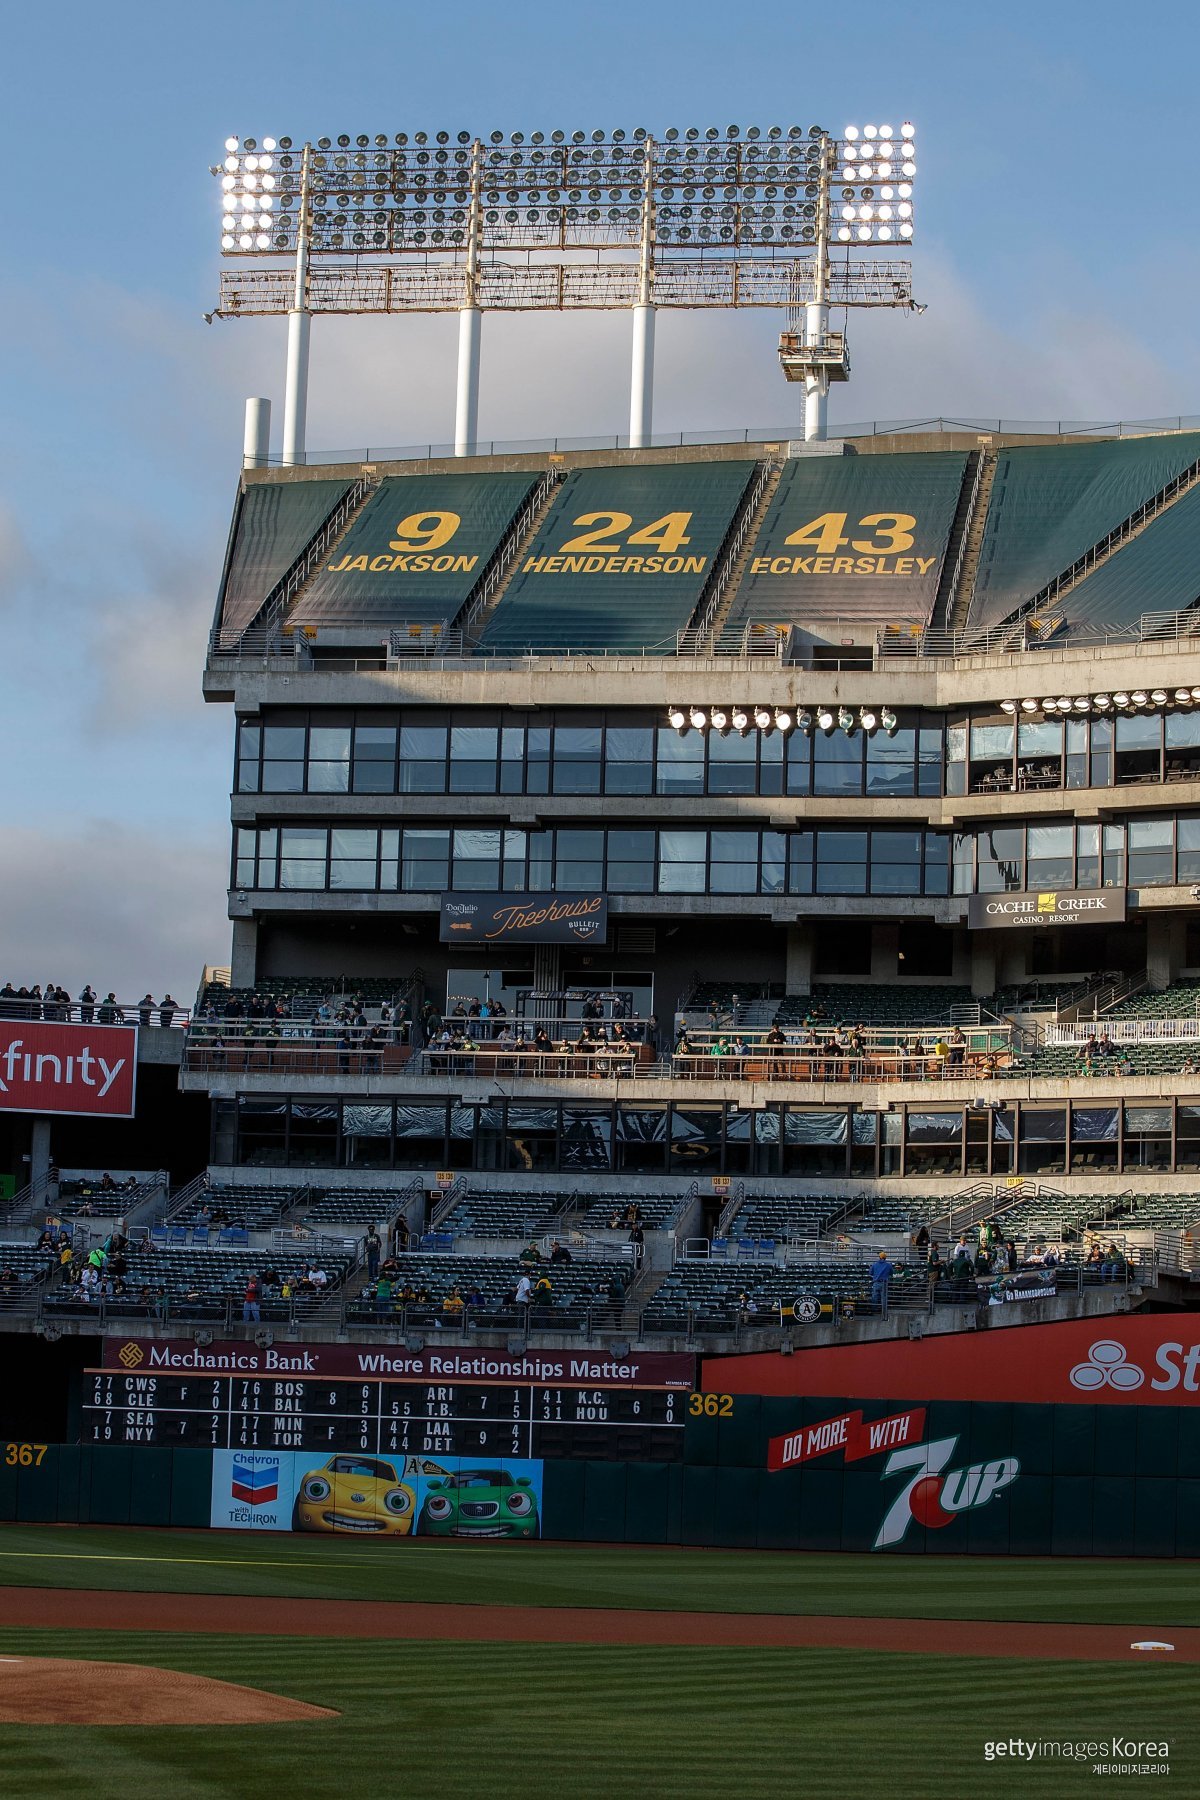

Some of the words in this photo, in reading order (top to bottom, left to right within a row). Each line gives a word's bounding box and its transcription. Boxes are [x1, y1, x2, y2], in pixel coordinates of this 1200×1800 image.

[389, 511, 461, 552] 9
[559, 511, 692, 554] 24
[784, 512, 917, 555] 43
[328, 555, 478, 573] JACKSON
[523, 555, 707, 575] HENDERSON
[750, 557, 936, 576] ECKERSLEY
[986, 901, 1035, 914] CACHE
[1058, 897, 1108, 911] CREEK
[485, 897, 602, 938] Treehouse
[568, 921, 600, 929] BULLEIT
[1013, 915, 1044, 924] CASINO
[1049, 914, 1080, 923] RESORT
[149, 1346, 258, 1369] Mechanics
[265, 1350, 316, 1371] Bank
[358, 1354, 423, 1374] Where
[430, 1357, 563, 1380] Relationships
[570, 1361, 639, 1379] Matter
[1151, 1342, 1200, 1392] St
[125, 1378, 156, 1391] CWS
[213, 1381, 219, 1393] 2
[275, 1383, 303, 1395] BOS
[363, 1386, 369, 1397] 6
[128, 1394, 154, 1406] CLE
[213, 1397, 219, 1409] 0
[181, 1388, 187, 1400] F
[330, 1393, 336, 1405] 8
[428, 1388, 453, 1400] ARI
[514, 1390, 519, 1402] 1
[578, 1392, 604, 1404] K.C.
[667, 1394, 674, 1406] 8
[275, 1399, 302, 1412] BAL
[362, 1402, 368, 1413] 5
[427, 1403, 452, 1416] T.B.
[513, 1406, 519, 1418] 5
[481, 1397, 487, 1409] 7
[633, 1401, 639, 1413] 6
[689, 1394, 733, 1416] 362
[105, 1412, 111, 1424] 7
[126, 1412, 154, 1425] SEA
[212, 1416, 218, 1428] 2
[577, 1408, 607, 1420] HOU
[667, 1410, 673, 1423] 0
[180, 1422, 186, 1434] 7
[274, 1418, 302, 1430] MIN
[361, 1421, 367, 1432] 3
[427, 1423, 449, 1435] LAA
[512, 1425, 519, 1437] 4
[126, 1428, 153, 1440] NYY
[212, 1431, 216, 1443] 1
[274, 1433, 302, 1445] TOR
[361, 1437, 367, 1448] 0
[328, 1427, 334, 1439] F
[480, 1432, 486, 1444] 9
[782, 1435, 802, 1464] DO
[806, 1417, 849, 1456] MORE
[869, 1415, 910, 1450] WITH
[424, 1438, 452, 1451] DET
[512, 1441, 518, 1453] 2
[5, 1443, 48, 1466] 367
[233, 1453, 280, 1465] Chevron
[228, 1510, 277, 1525] TECHRON
[234, 1506, 249, 1514] with
